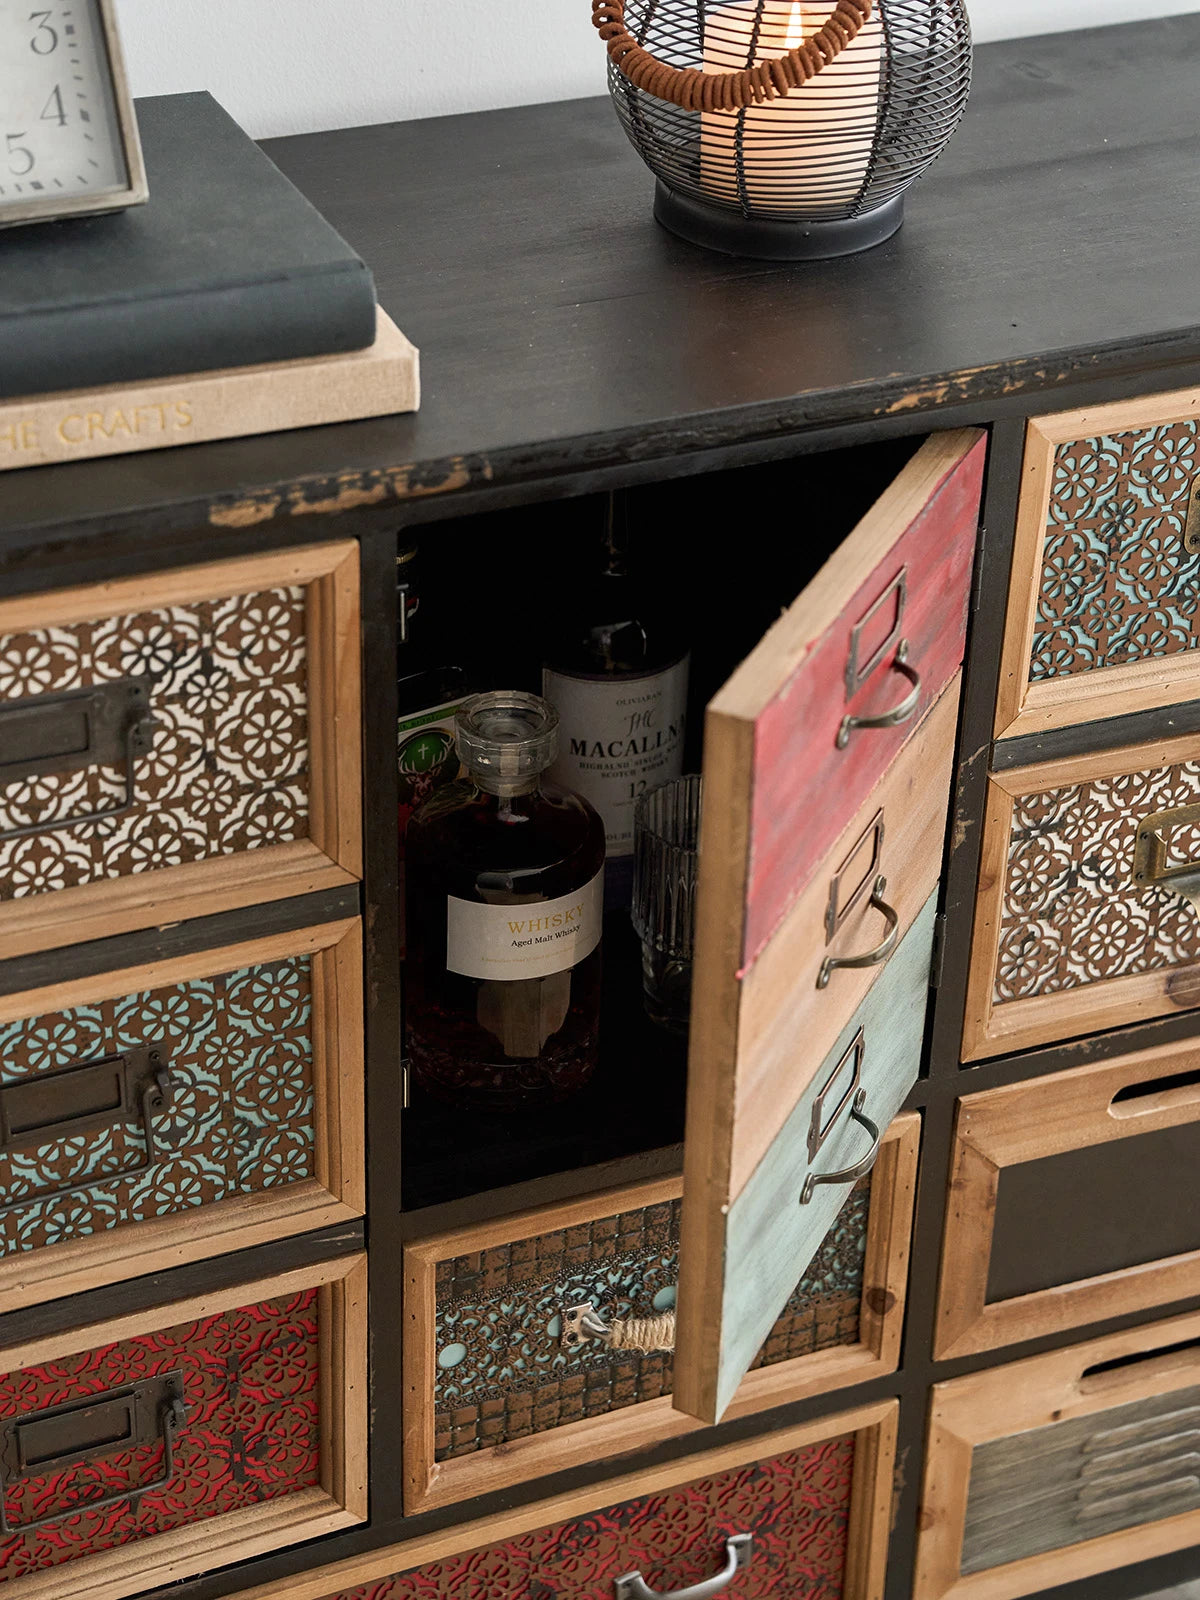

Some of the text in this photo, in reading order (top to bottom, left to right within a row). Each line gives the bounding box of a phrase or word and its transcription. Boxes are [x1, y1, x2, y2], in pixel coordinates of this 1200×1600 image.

[29, 11, 58, 55] 3
[40, 84, 68, 127] 4
[6, 132, 35, 176] 5
[58, 401, 193, 444] CRAFTS
[630, 780, 648, 799] 12
[508, 903, 585, 934] WHISKY
[511, 924, 581, 948] Aged Malt Whisky
